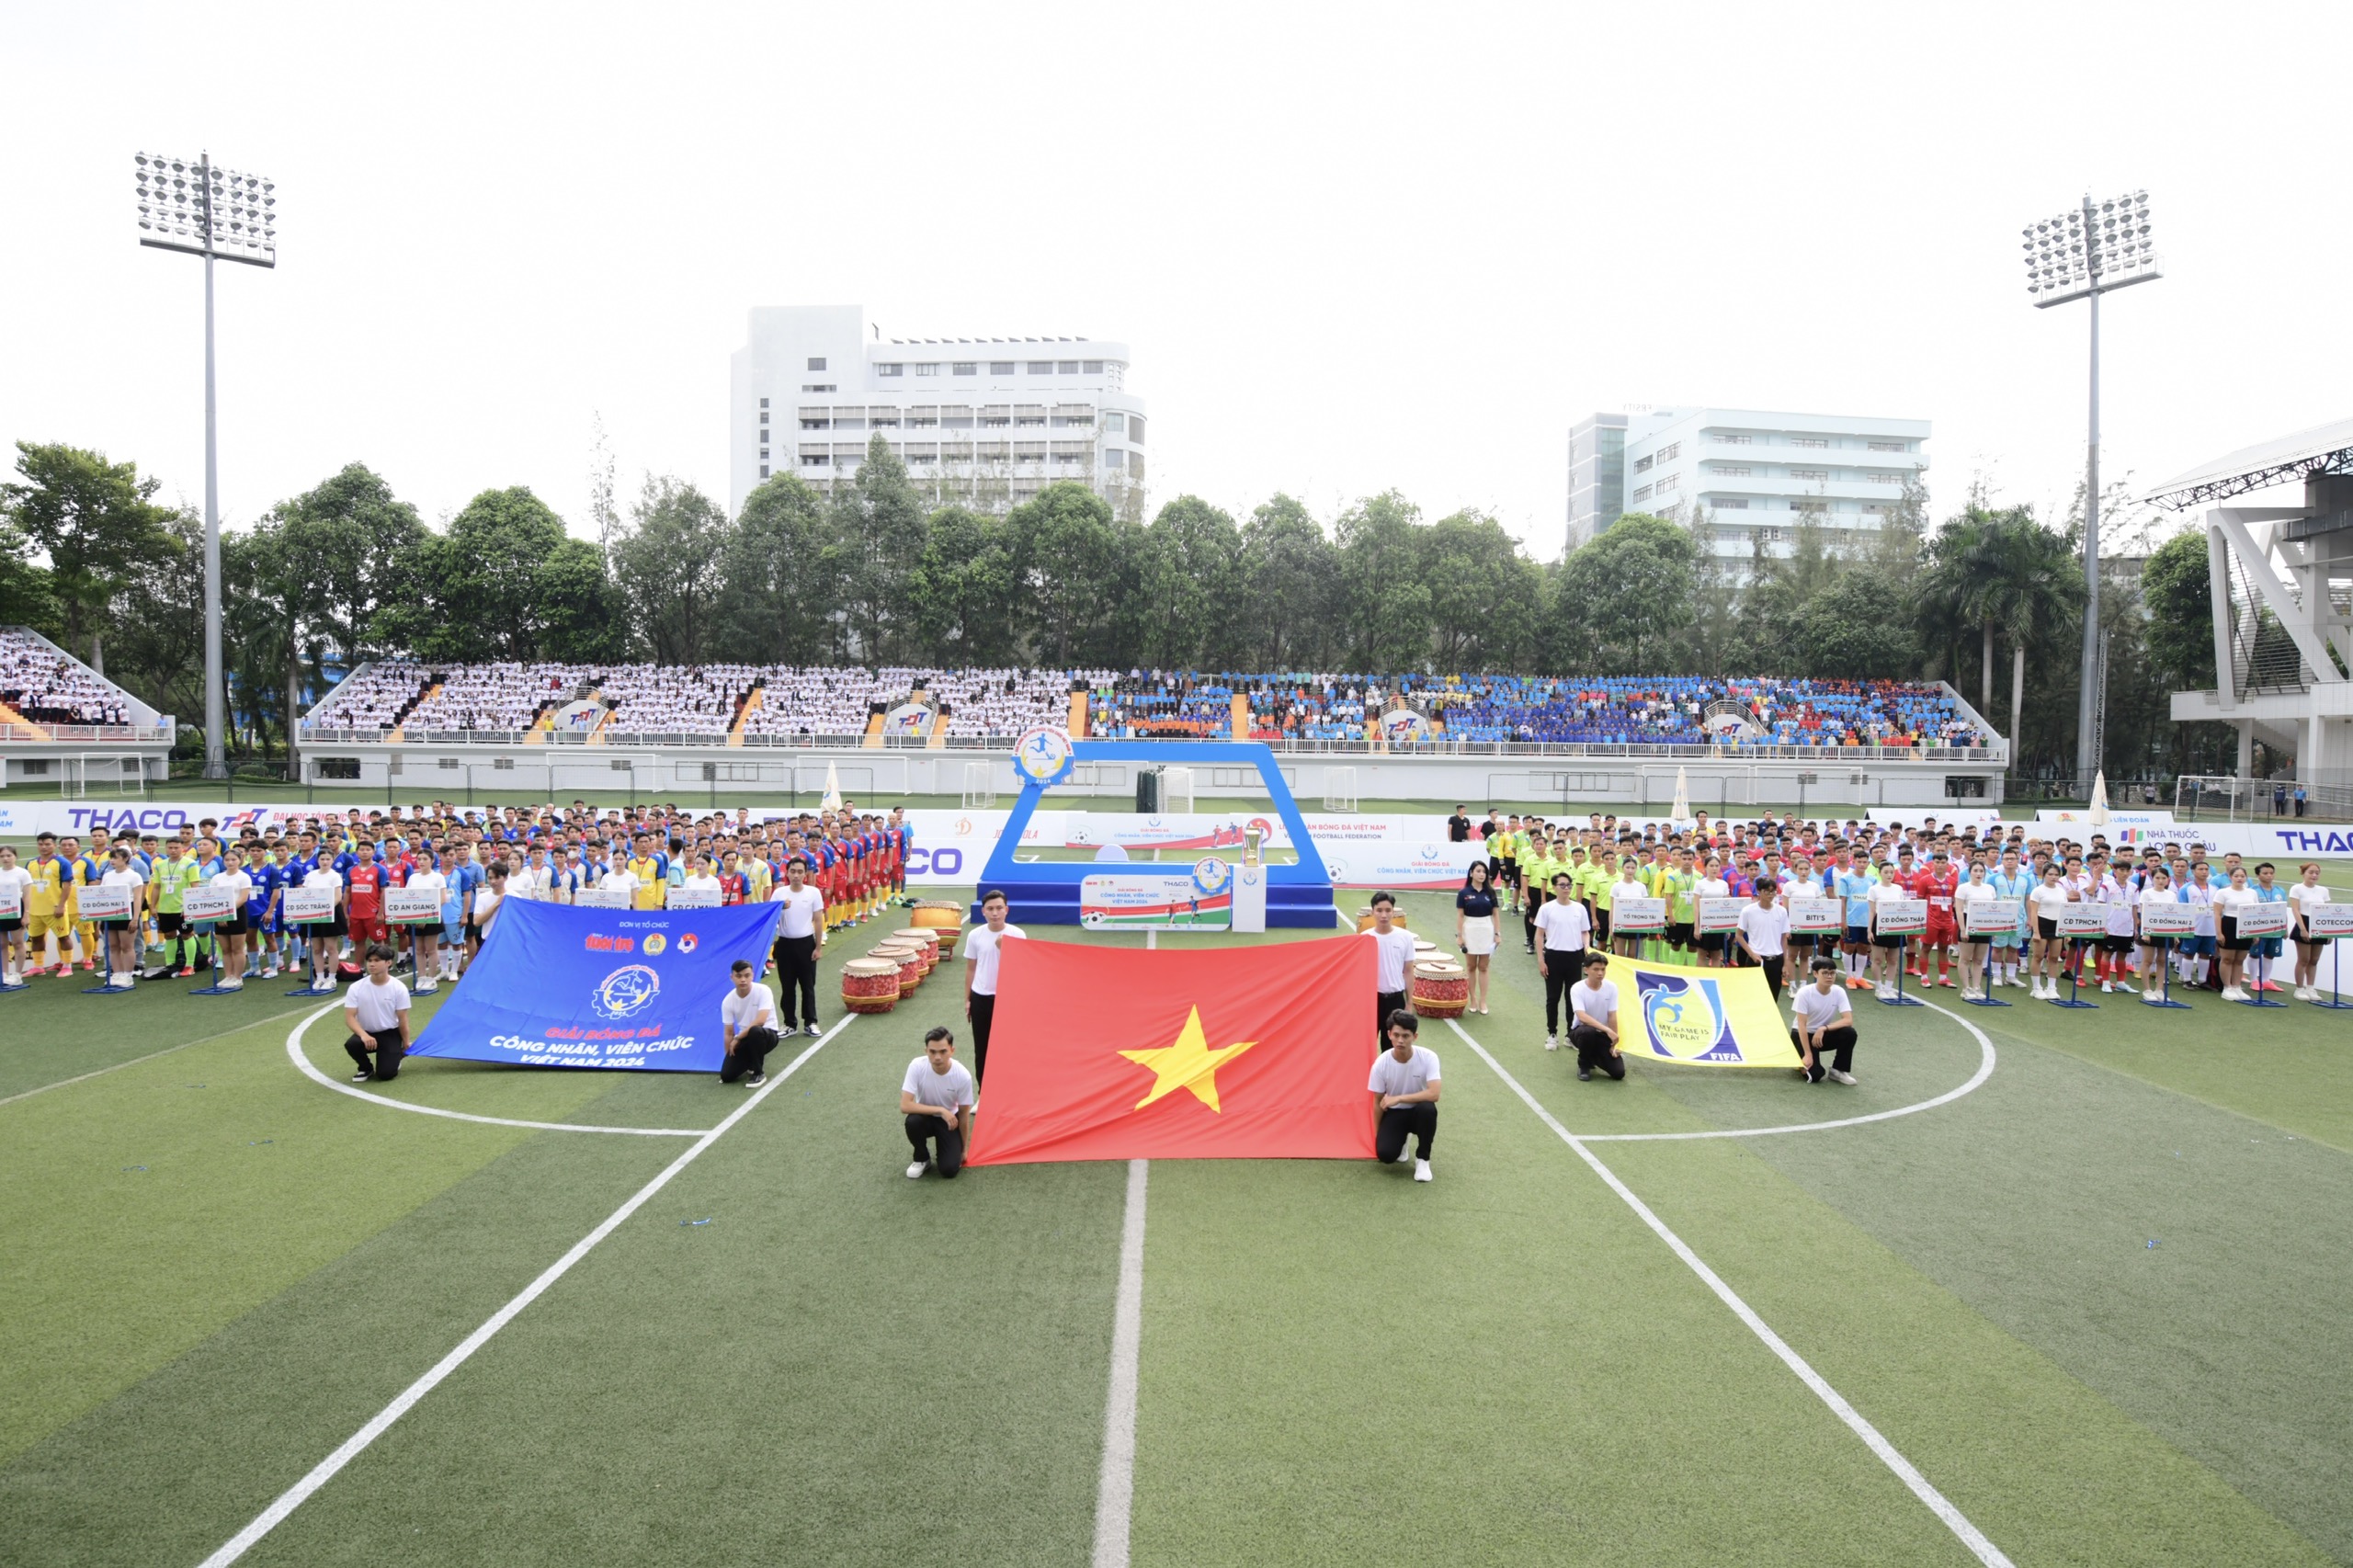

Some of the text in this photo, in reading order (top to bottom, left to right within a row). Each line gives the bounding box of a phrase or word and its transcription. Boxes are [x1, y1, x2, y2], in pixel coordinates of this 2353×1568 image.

[68, 809, 187, 829] THACO
[1353, 824, 1369, 832] VIỆT
[2147, 828, 2200, 838] NHÀ THUỐC
[642, 921, 651, 929] TỔ
[545, 1023, 663, 1040] GIẢI BÓNG ĐÁ
[1674, 1027, 1699, 1035] GAME
[1680, 1032, 1699, 1040] PLAY
[489, 1036, 696, 1056] CÔNG NHÂN, VIÊN CHỨC
[520, 1053, 646, 1067] VIỆT NAM 2024
